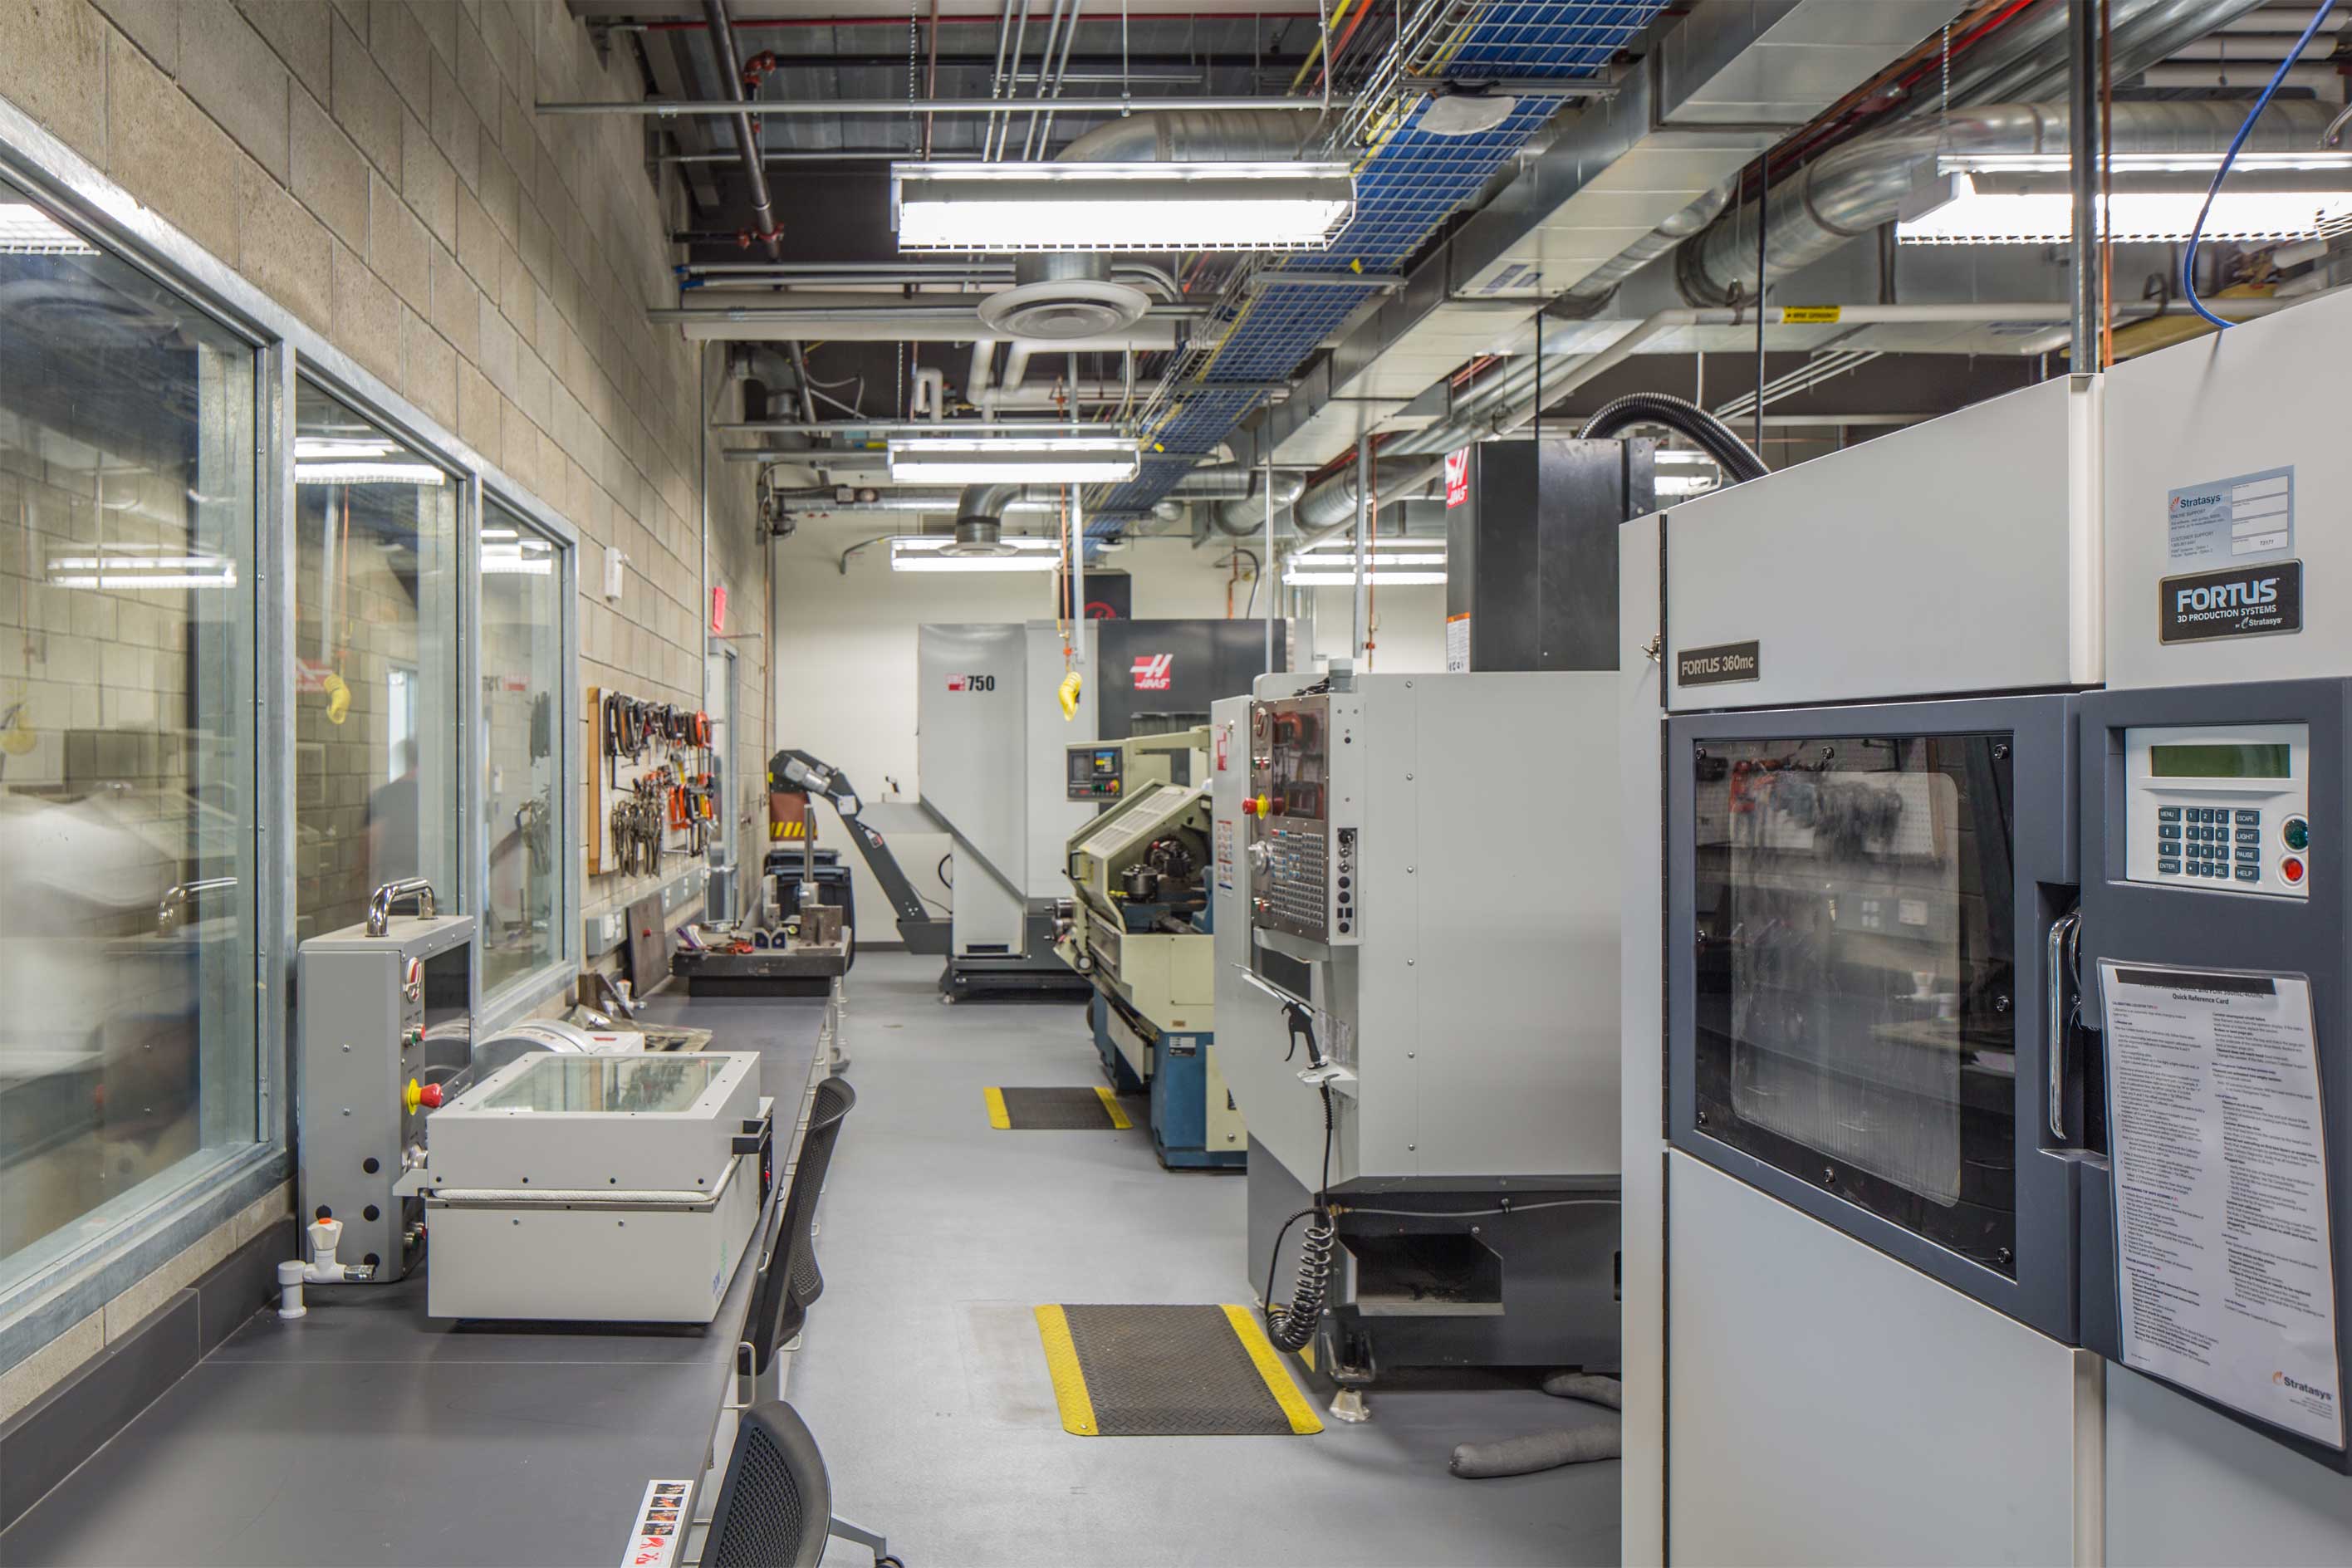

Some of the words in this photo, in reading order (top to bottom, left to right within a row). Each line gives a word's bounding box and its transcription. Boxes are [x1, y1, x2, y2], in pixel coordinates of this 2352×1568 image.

[2180, 494, 2222, 508] Stratasys
[2178, 579, 2277, 613] FORTUS
[2178, 615, 2188, 623] 3D
[2188, 609, 2239, 622] PRODUCTION
[2241, 605, 2277, 616] SYSTEMS
[2248, 617, 2282, 627] Stratasys
[1681, 657, 1721, 676] FORTUS
[1722, 654, 1754, 671] 360mc
[967, 674, 995, 691] 750
[2172, 992, 2188, 1001] Quick
[2188, 994, 2215, 1003] Reference
[2216, 997, 2230, 1005] Card
[2284, 1376, 2332, 1400] Stratasys
